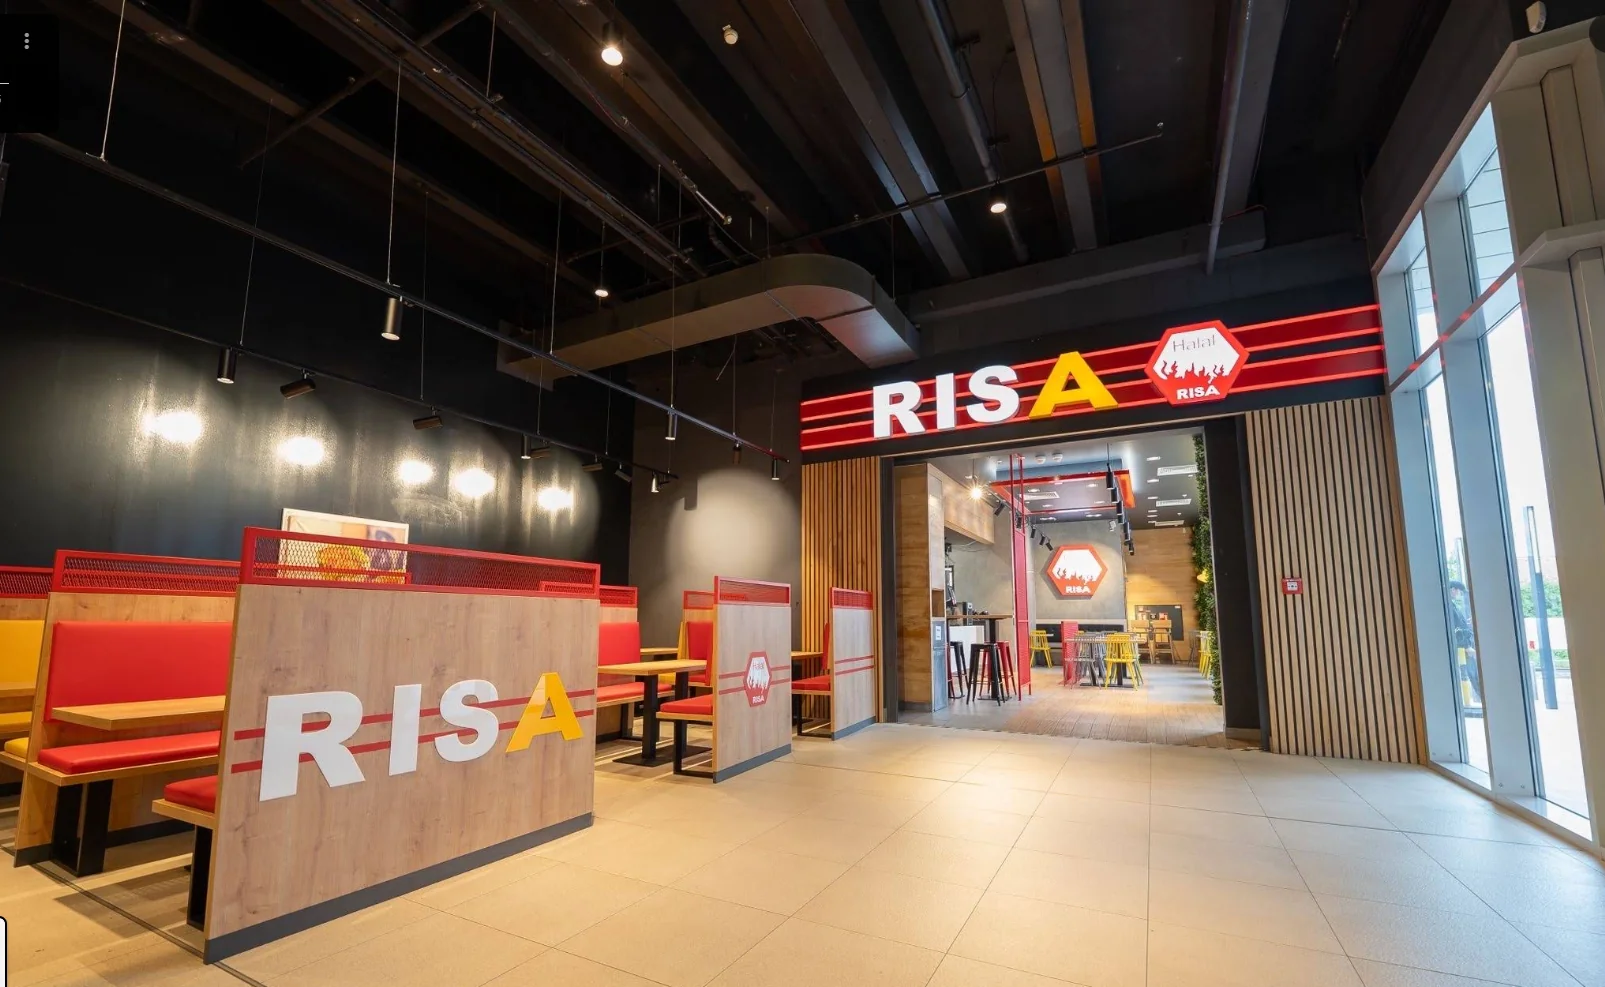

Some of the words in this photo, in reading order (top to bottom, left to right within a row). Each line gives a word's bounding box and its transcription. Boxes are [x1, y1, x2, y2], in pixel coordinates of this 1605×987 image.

[1173, 334, 1216, 352] Halal
[873, 351, 1119, 439] RISA
[1177, 385, 1221, 400] RISA
[1065, 585, 1092, 594] RISA
[752, 695, 765, 704] RISA
[259, 672, 585, 802] RISA
